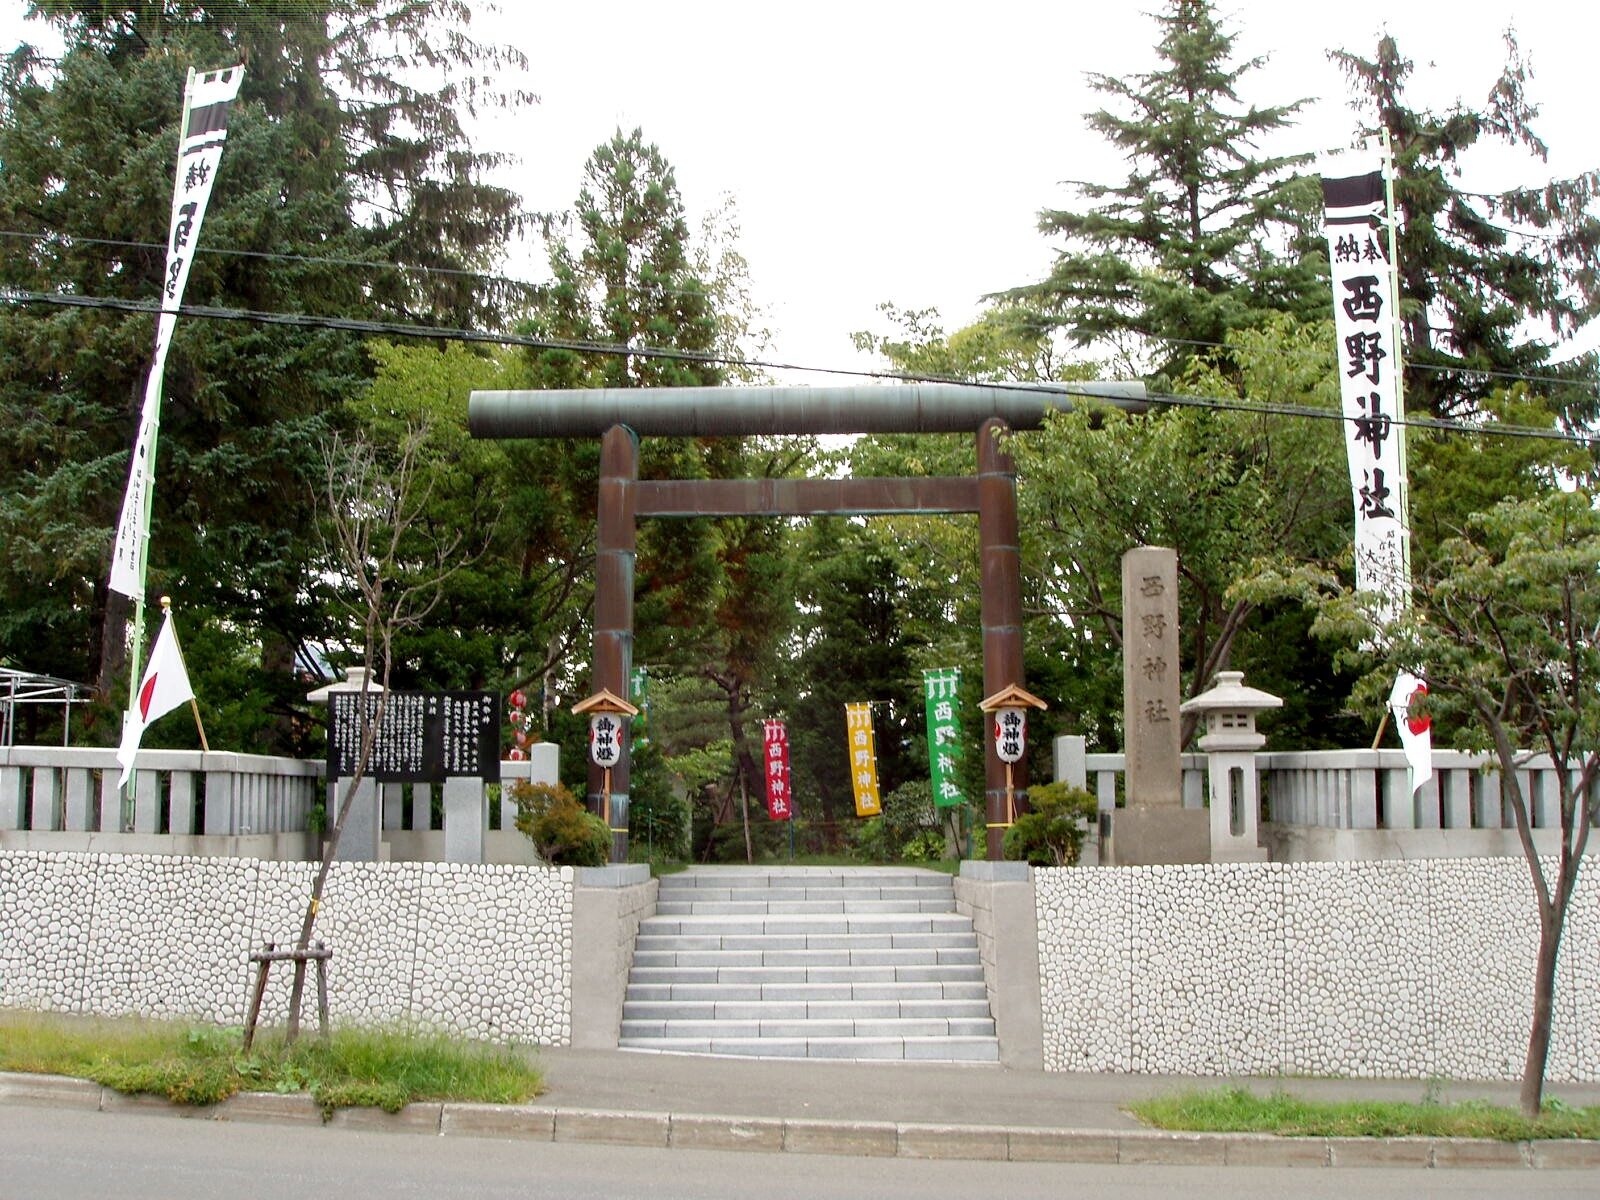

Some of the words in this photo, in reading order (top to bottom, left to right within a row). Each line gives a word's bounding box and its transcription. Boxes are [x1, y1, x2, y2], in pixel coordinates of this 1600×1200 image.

[1335, 232, 1382, 264] 奉納
[1342, 275, 1395, 521] 西野神社
[1140, 575, 1170, 723] 西野神社
[596, 716, 615, 760] 御神燈
[854, 729, 875, 809] 西野神社
[934, 701, 961, 800] 西野神社
[1003, 711, 1021, 755] 御神燈
[768, 743, 788, 814] 西野神社
